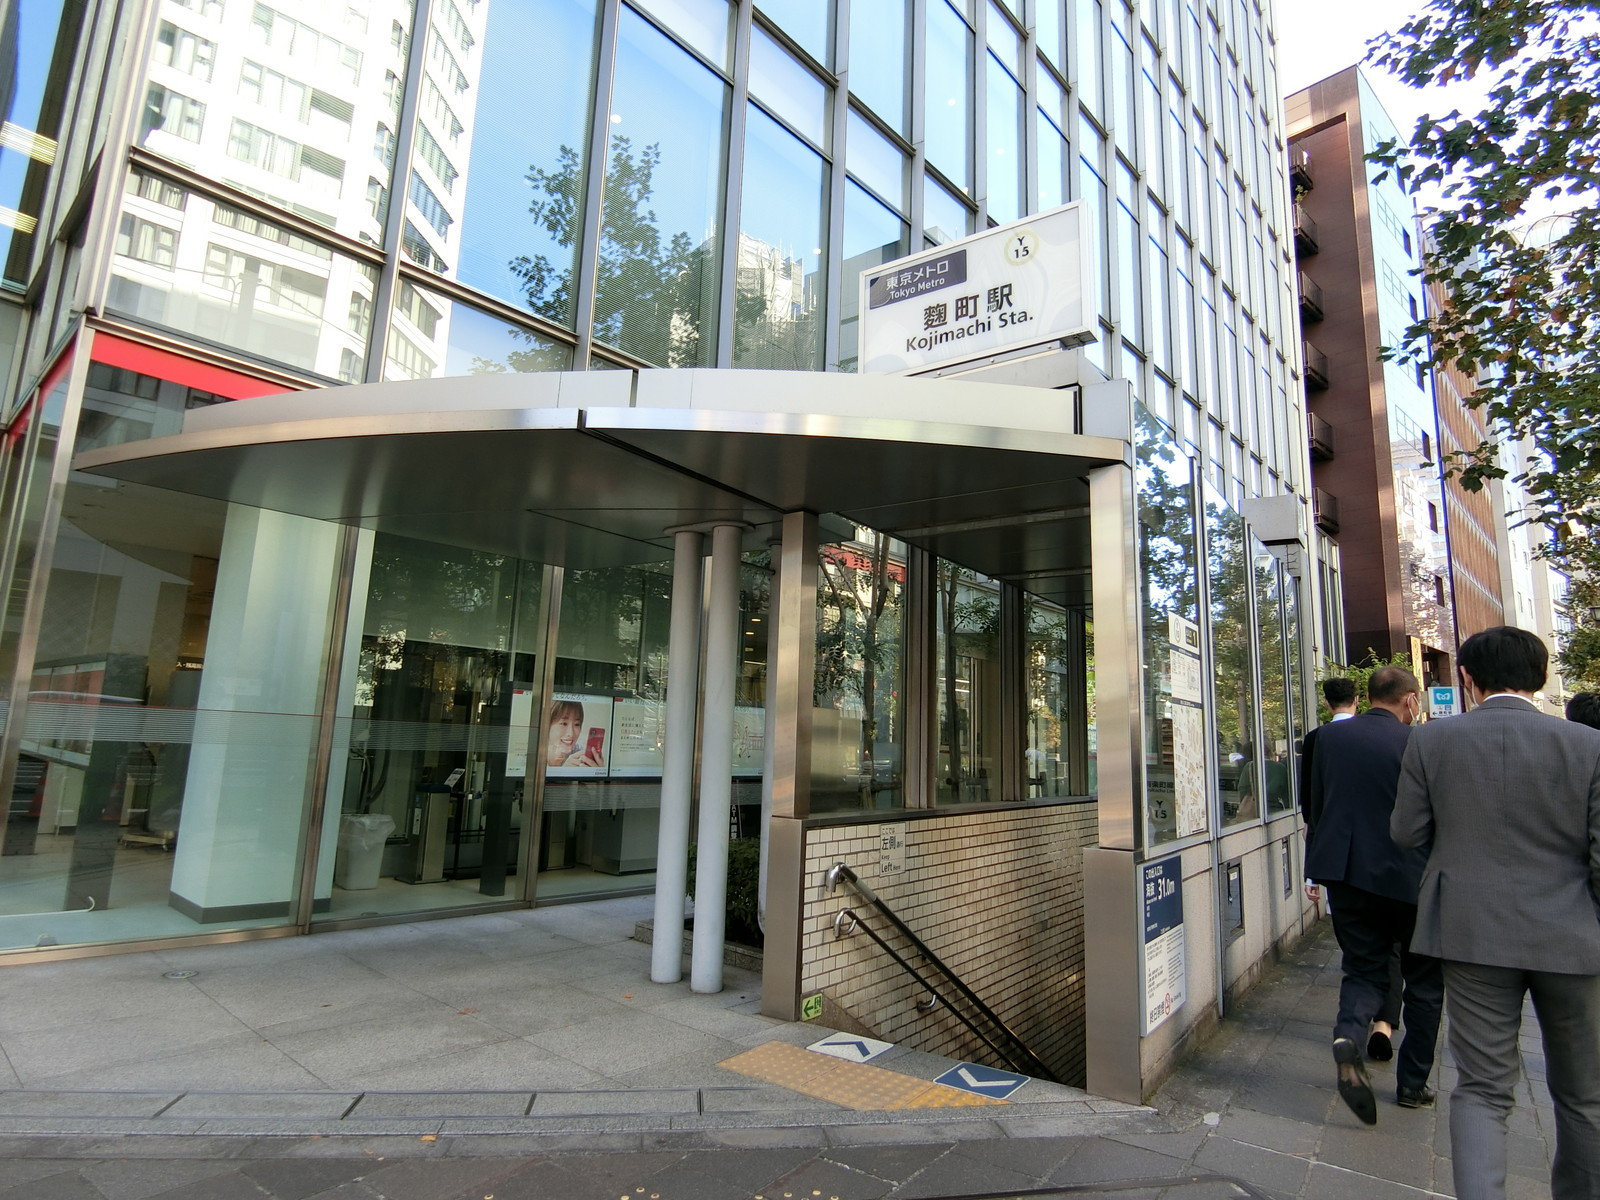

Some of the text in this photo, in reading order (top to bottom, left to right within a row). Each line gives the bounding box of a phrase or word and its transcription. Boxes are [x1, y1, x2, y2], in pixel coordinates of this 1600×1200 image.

[1017, 236, 1026, 246] Y
[1014, 246, 1029, 259] 15
[886, 260, 949, 291] 東京メトロ
[889, 276, 945, 300] Tokyo Metro
[906, 309, 1034, 353] Kojimachi Sta.
[1156, 799, 1164, 808] Y
[1154, 809, 1167, 819] 15
[881, 861, 893, 873] Left
[1157, 877, 1175, 900] 31.0m
